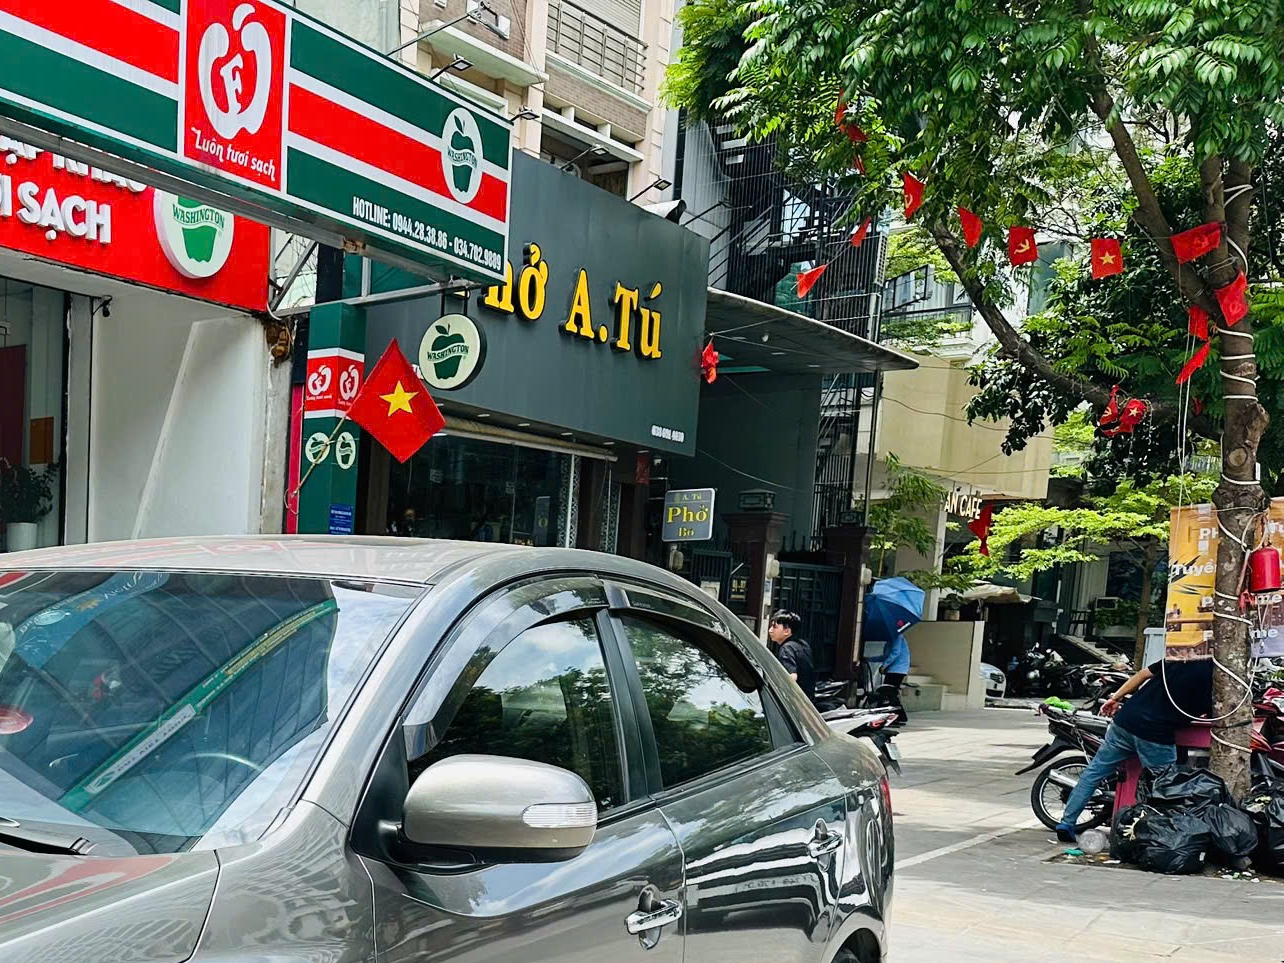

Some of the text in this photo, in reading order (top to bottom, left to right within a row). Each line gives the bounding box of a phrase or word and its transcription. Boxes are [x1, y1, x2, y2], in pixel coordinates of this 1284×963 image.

[191, 127, 276, 181] Luôn tươi sạch
[448, 146, 478, 168] WASHINGTON
[17, 182, 111, 243] SẠCH
[173, 204, 226, 228] WASHINGTON
[353, 196, 391, 227] HOTLINE:
[427, 344, 469, 360] WASHINGTON
[667, 504, 709, 523] Phở
